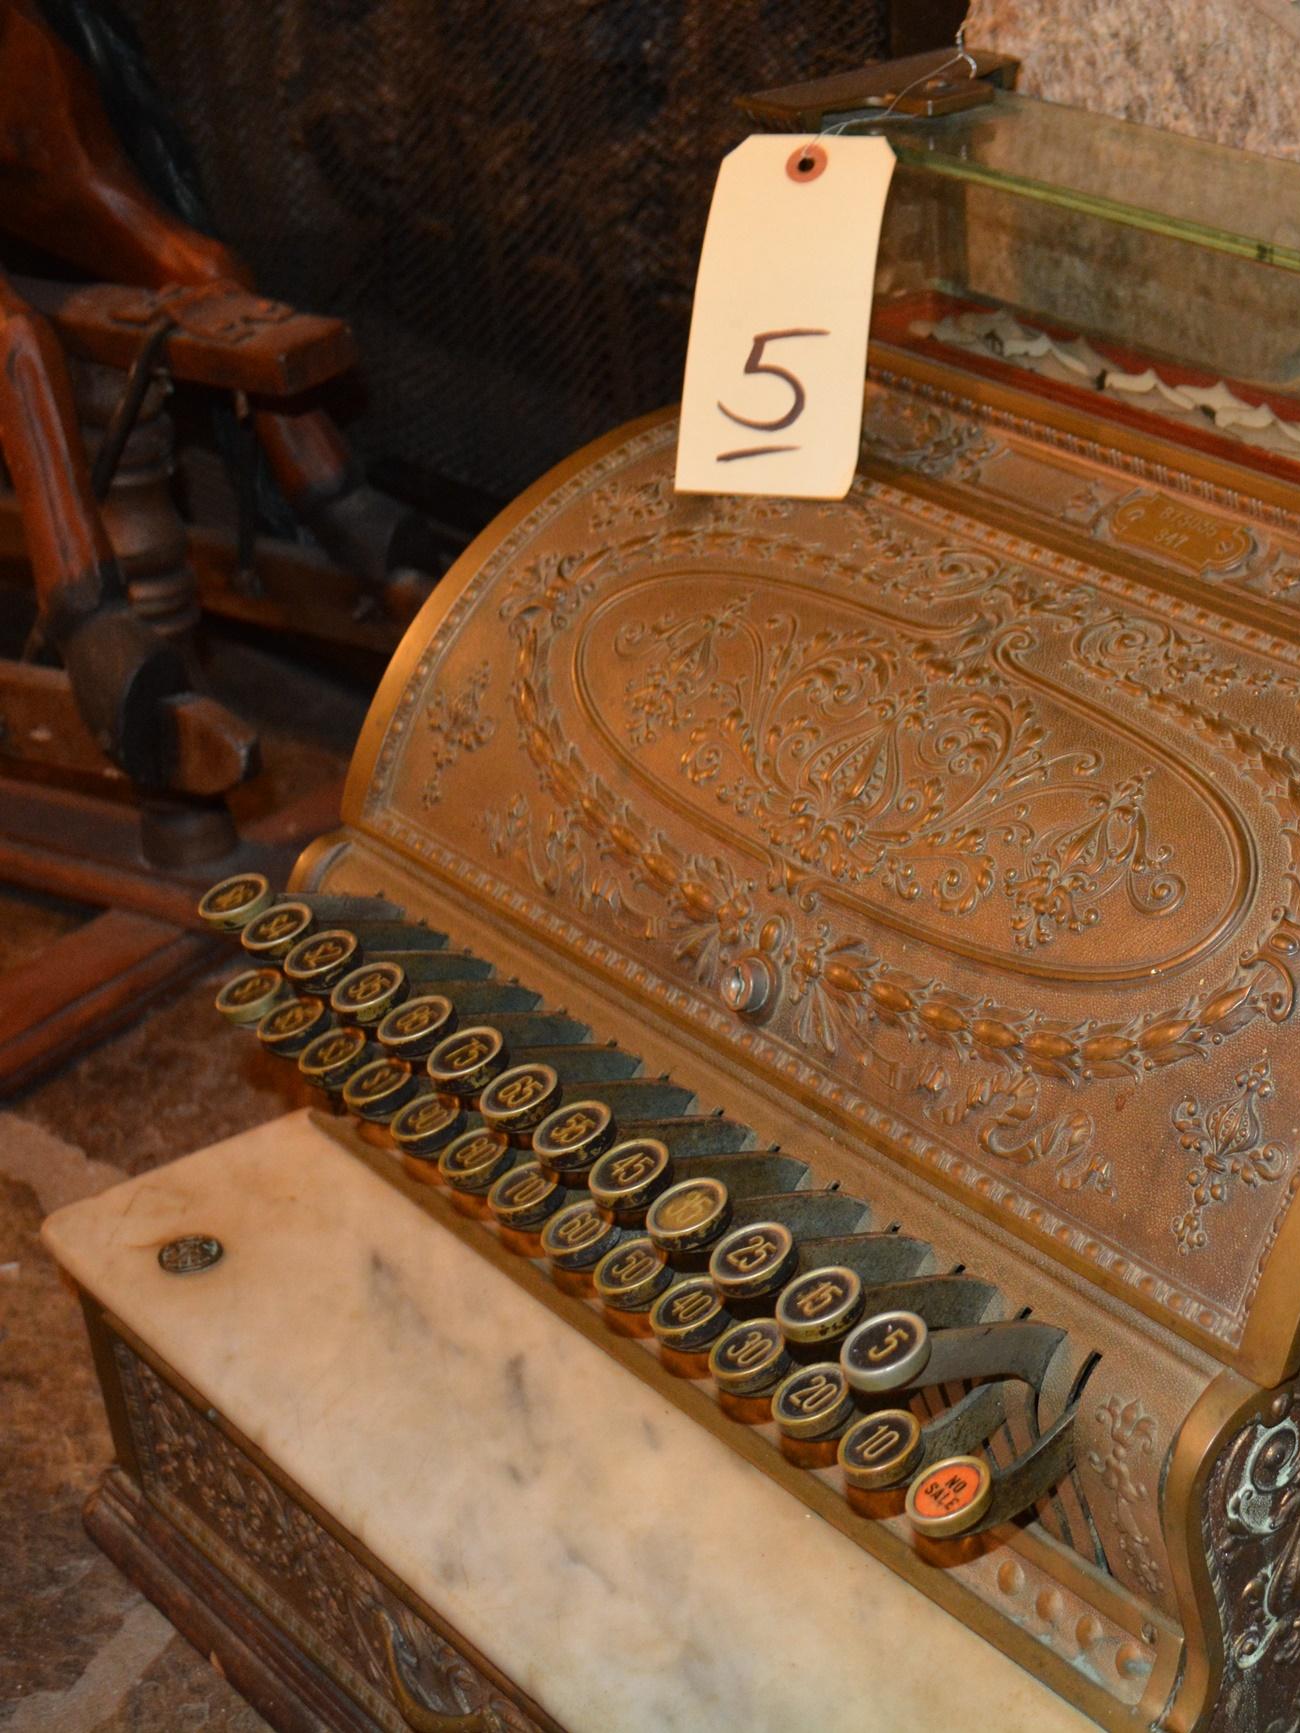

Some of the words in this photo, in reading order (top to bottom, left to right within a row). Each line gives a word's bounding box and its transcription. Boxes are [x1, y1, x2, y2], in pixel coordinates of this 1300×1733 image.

[717, 328, 831, 431] 5
[396, 1005, 438, 1033] 85
[445, 1037, 488, 1068] 75
[498, 1075, 543, 1107] 65
[408, 1102, 448, 1132] 90
[551, 1112, 595, 1143] 55
[456, 1137, 497, 1168] 80
[611, 1152, 655, 1184] 45
[505, 1172, 546, 1205] 70
[558, 1212, 601, 1244] 60
[612, 1249, 655, 1282] 50
[726, 1235, 776, 1272] 25
[672, 1290, 713, 1323] 40
[797, 1281, 843, 1317] 15
[728, 1331, 773, 1365] 30
[868, 1327, 910, 1361] 5
[790, 1375, 838, 1413] 20
[856, 1424, 900, 1460] 10
[924, 1482, 960, 1511] SALE
[945, 1475, 967, 1493] NO
